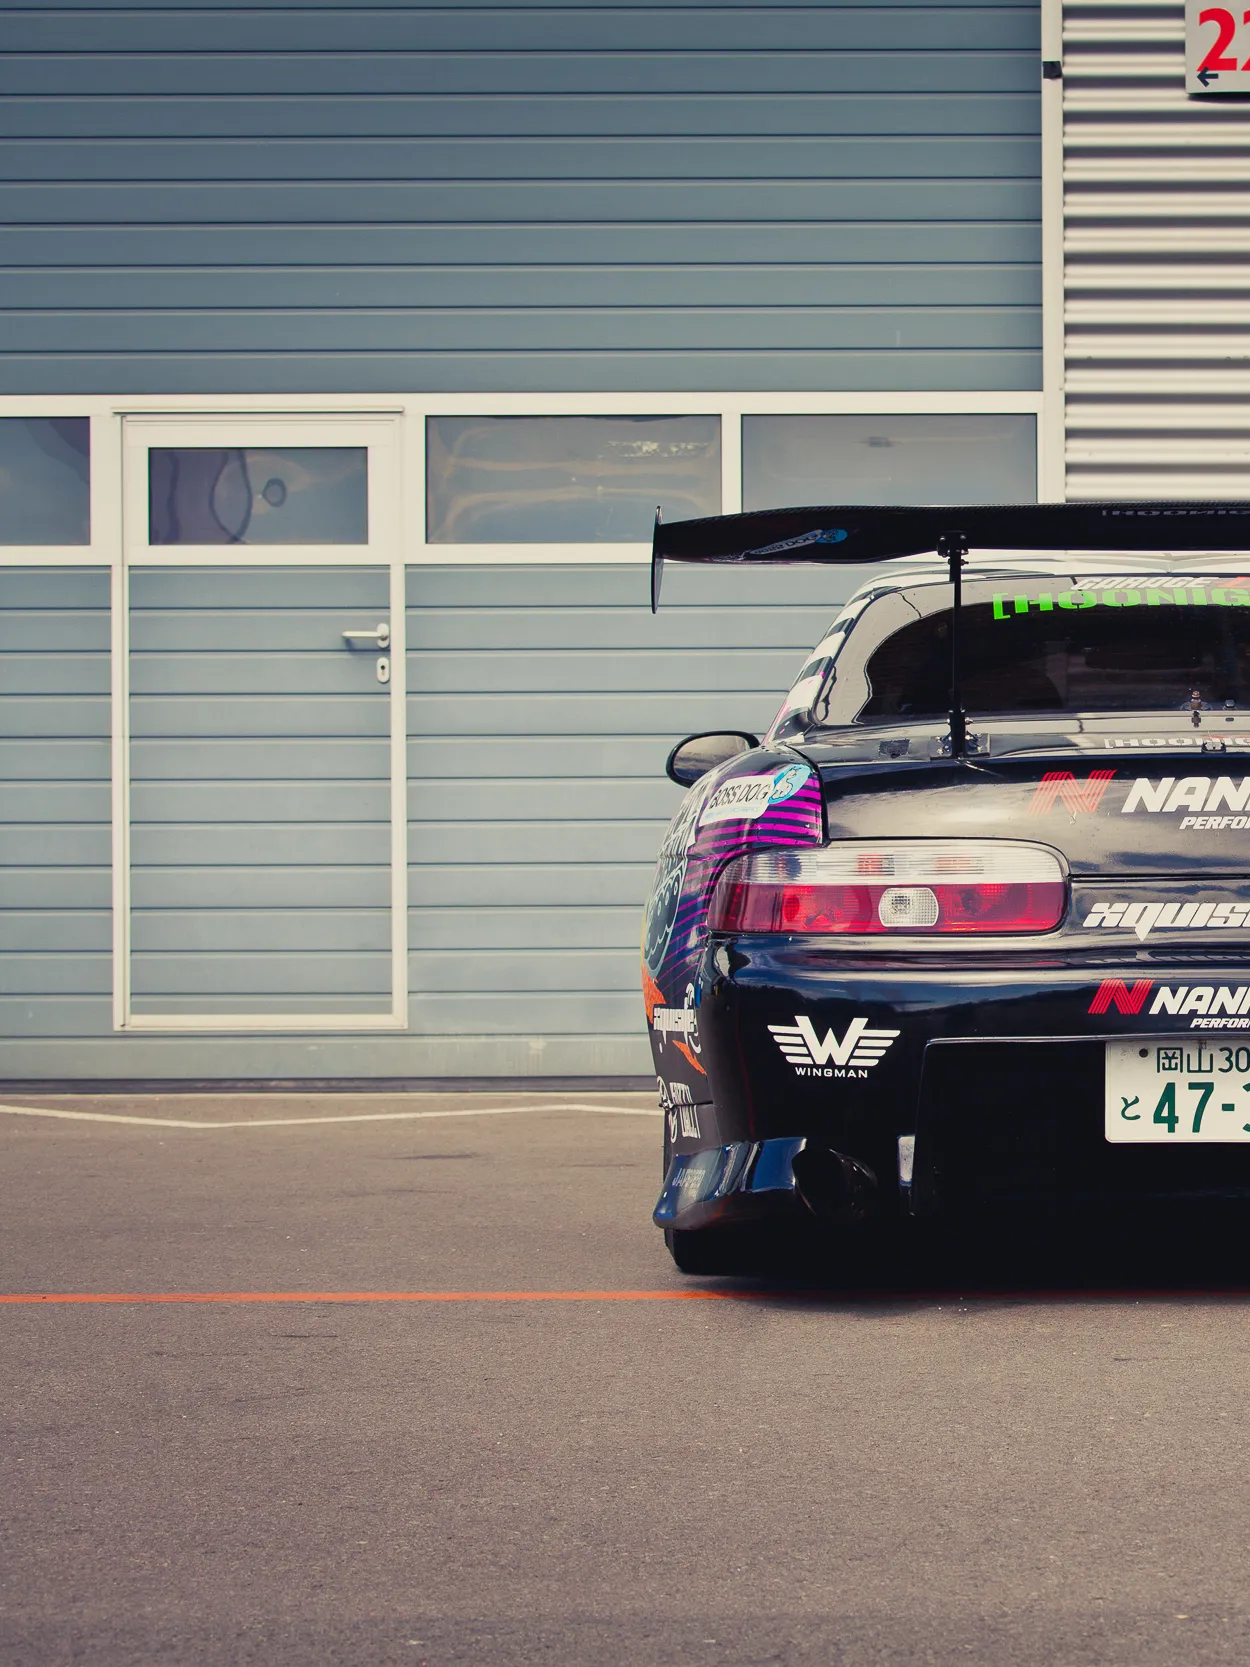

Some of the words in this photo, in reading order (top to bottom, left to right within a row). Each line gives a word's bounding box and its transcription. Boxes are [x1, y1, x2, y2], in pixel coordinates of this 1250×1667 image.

[1156, 1046, 1214, 1073] 岡山
[795, 1067, 869, 1079] WINGMAN
[1120, 1095, 1142, 1121] と
